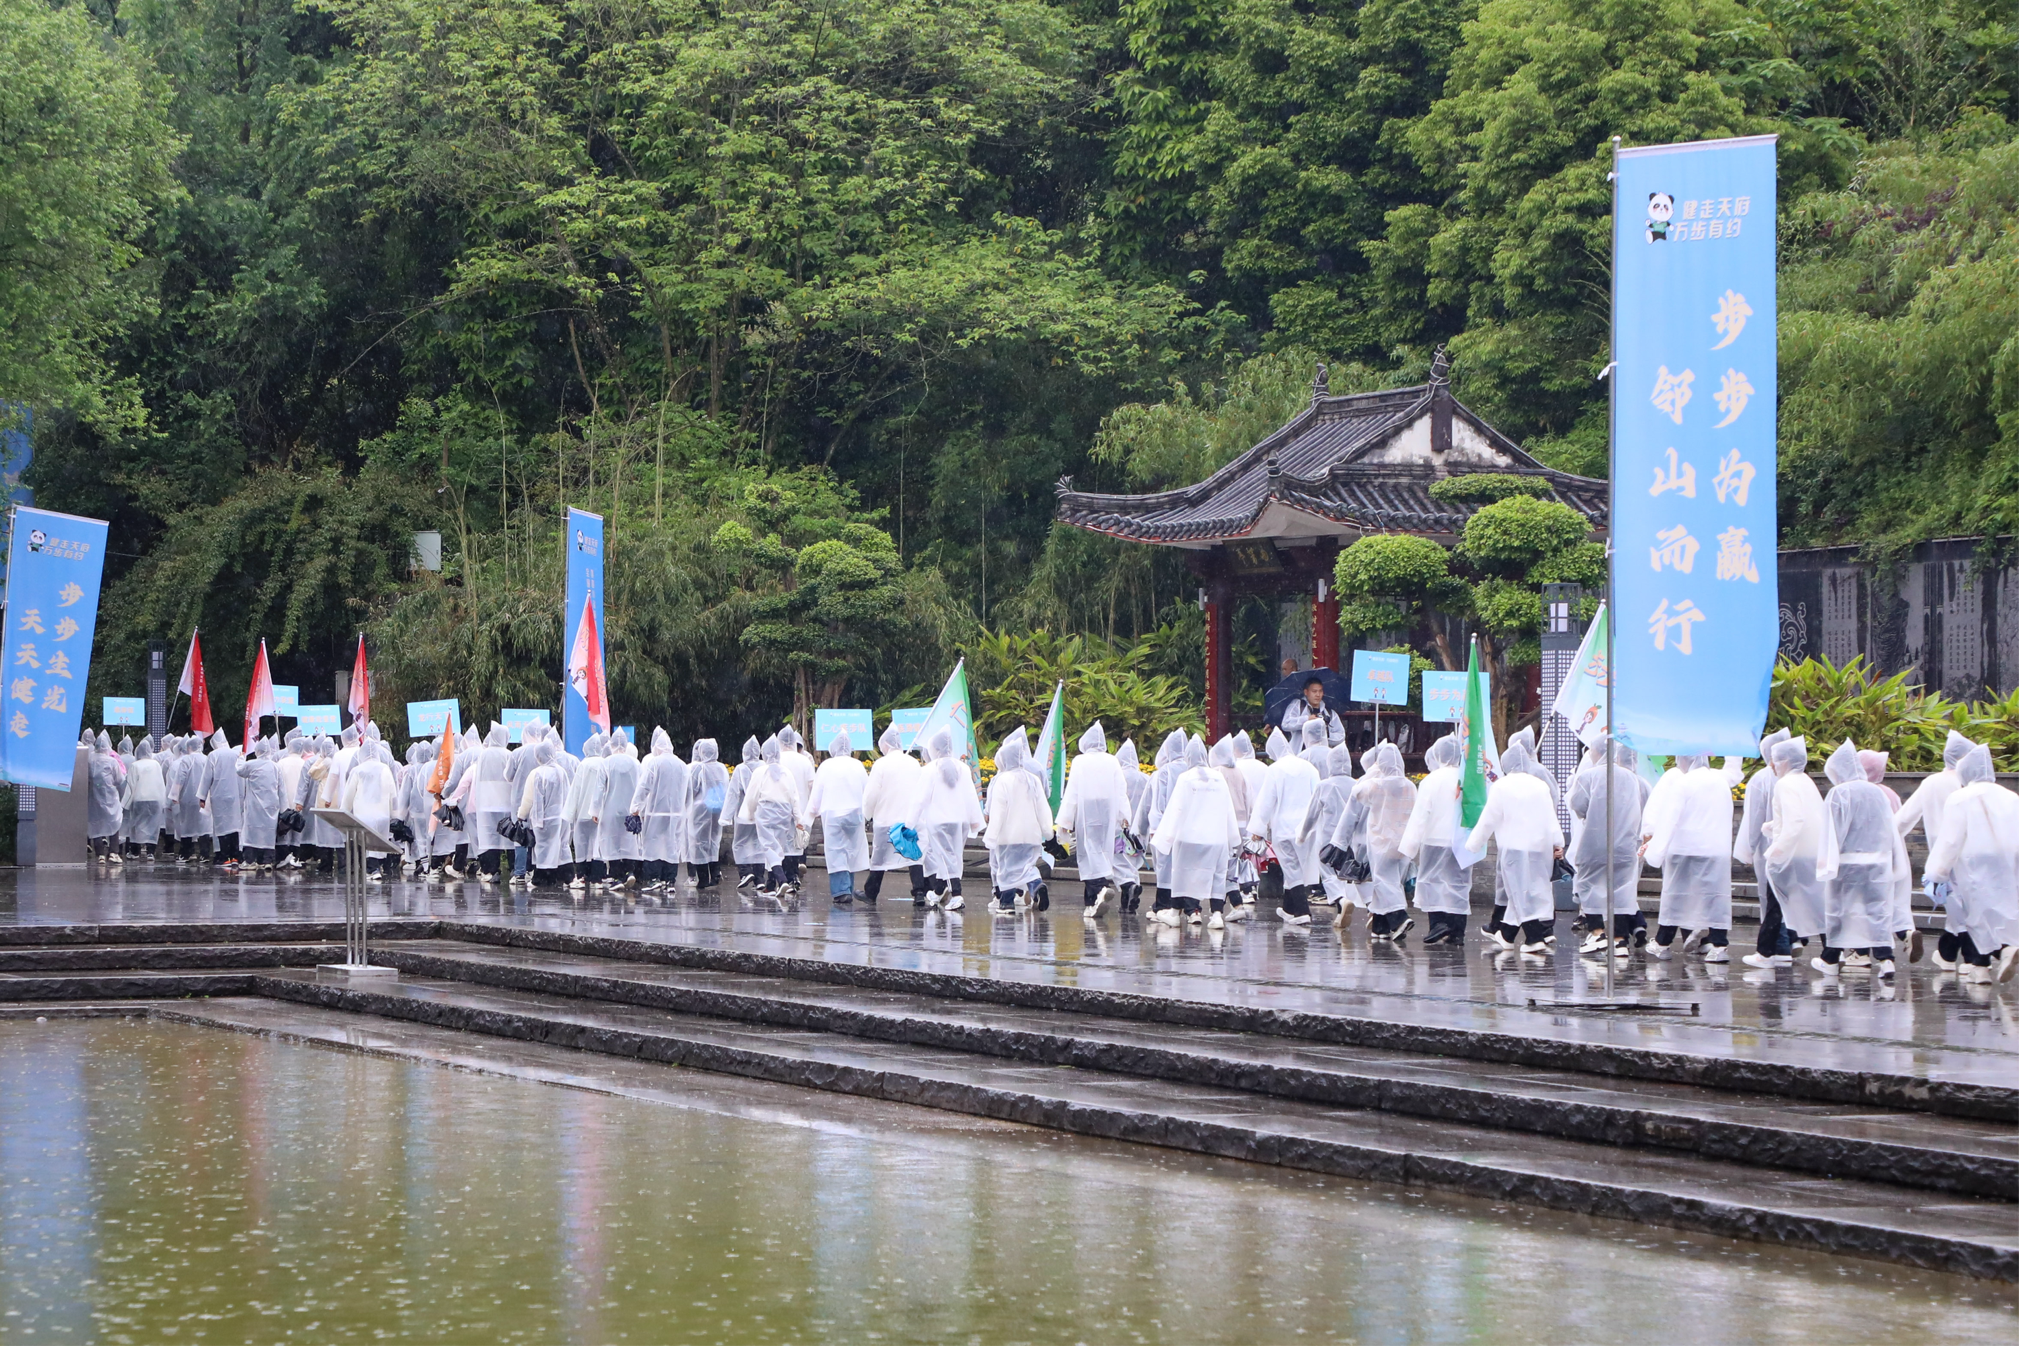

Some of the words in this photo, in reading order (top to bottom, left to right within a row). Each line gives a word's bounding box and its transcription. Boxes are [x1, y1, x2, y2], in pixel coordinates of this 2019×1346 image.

[1673, 217, 1742, 243] 万步有约
[1682, 195, 1752, 221] 健走天府
[1711, 289, 1760, 584] 步步为赢
[1649, 364, 1706, 656] 邻山而行
[9, 608, 46, 739] 天天健走
[41, 581, 85, 714] 步步生光
